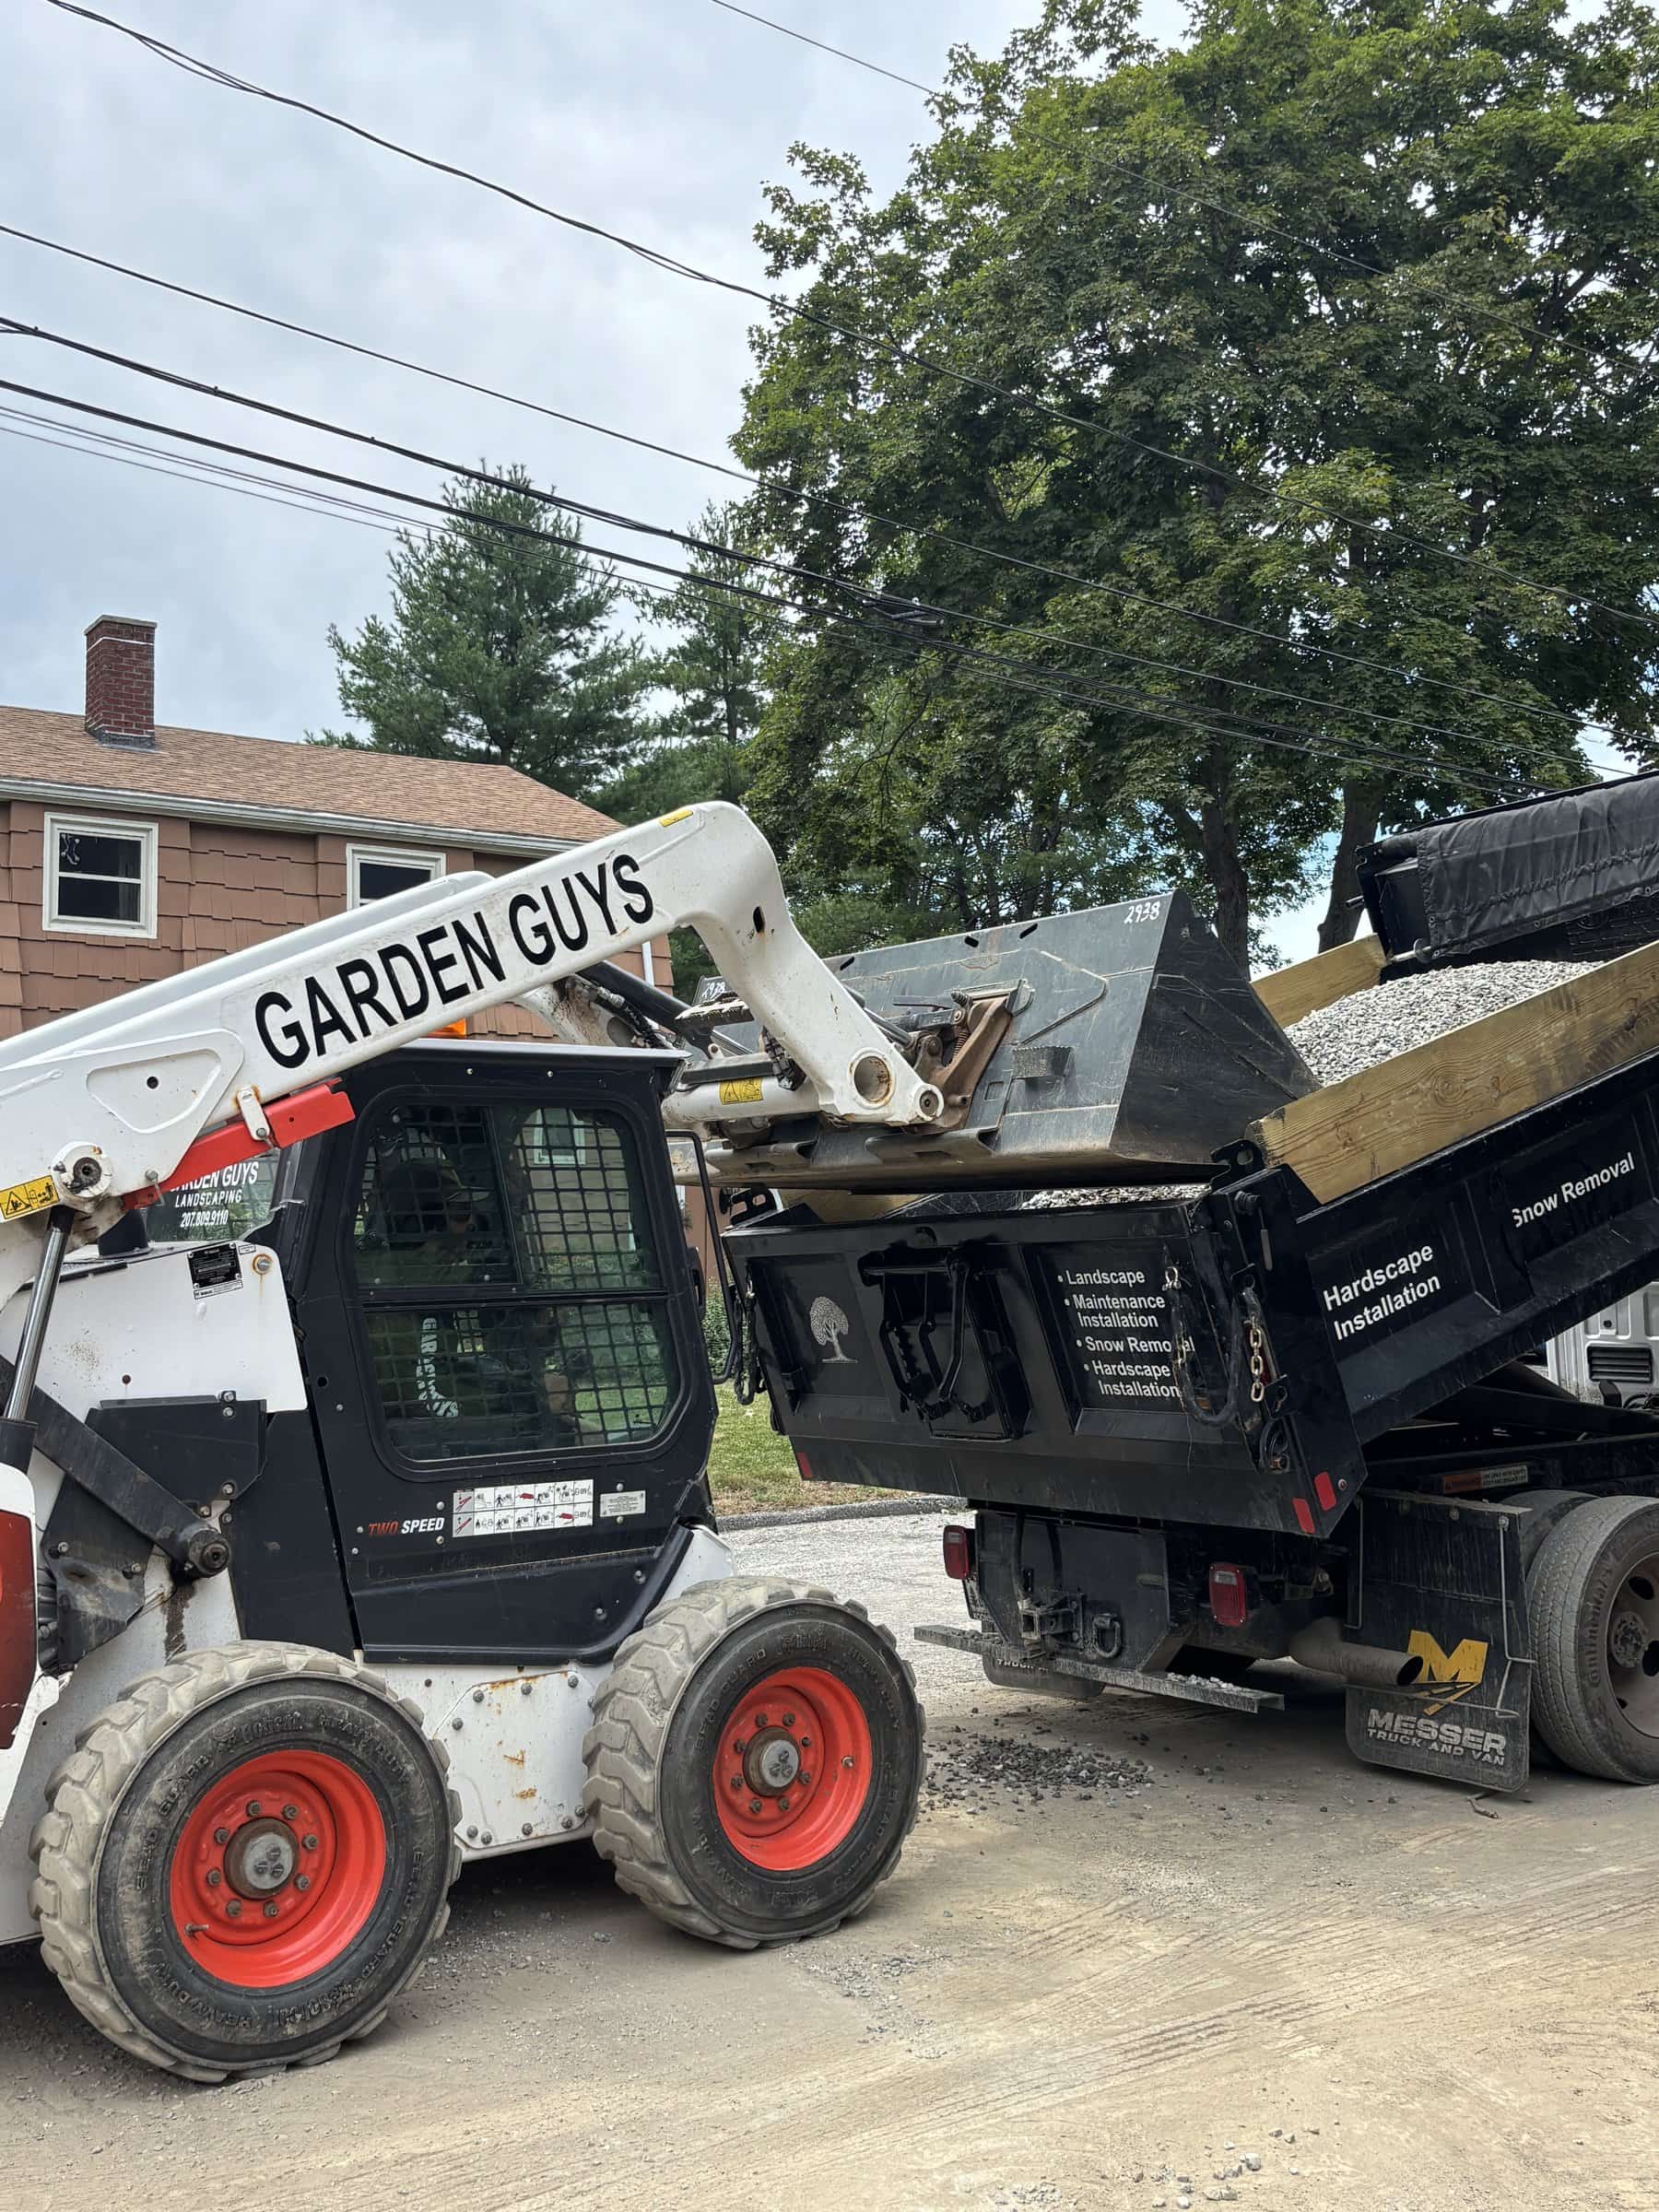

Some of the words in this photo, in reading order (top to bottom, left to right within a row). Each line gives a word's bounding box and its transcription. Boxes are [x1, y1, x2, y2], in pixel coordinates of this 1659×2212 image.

[1124, 900, 1160, 924] 2938
[255, 912, 506, 1069] GARDEN
[508, 853, 653, 965] GUYS
[221, 1160, 259, 1187] GUYS
[174, 1189, 242, 1208] LANDSCAPING
[1512, 1193, 1558, 1228] Snow
[1560, 1151, 1635, 1203] Removal
[180, 1208, 229, 1228] 207.809.9110
[1065, 1269, 1146, 1288] Landscape
[1323, 1245, 1433, 1312] Hardscape
[1072, 1294, 1166, 1310] Maintenance
[1334, 1275, 1441, 1340] Installation
[1077, 1312, 1159, 1328] Installation
[1085, 1336, 1124, 1352] Snow
[1126, 1336, 1195, 1353] Remoal
[1091, 1359, 1171, 1381] Hardscape
[1098, 1380, 1181, 1398] Installation
[368, 1521, 399, 1535] TWO
[401, 1517, 445, 1535] SPEED
[1368, 1709, 1506, 1756] MESSER
[1368, 1728, 1424, 1747] TRUCK
[1429, 1742, 1465, 1756] AND
[1472, 1750, 1505, 1766] VAN
